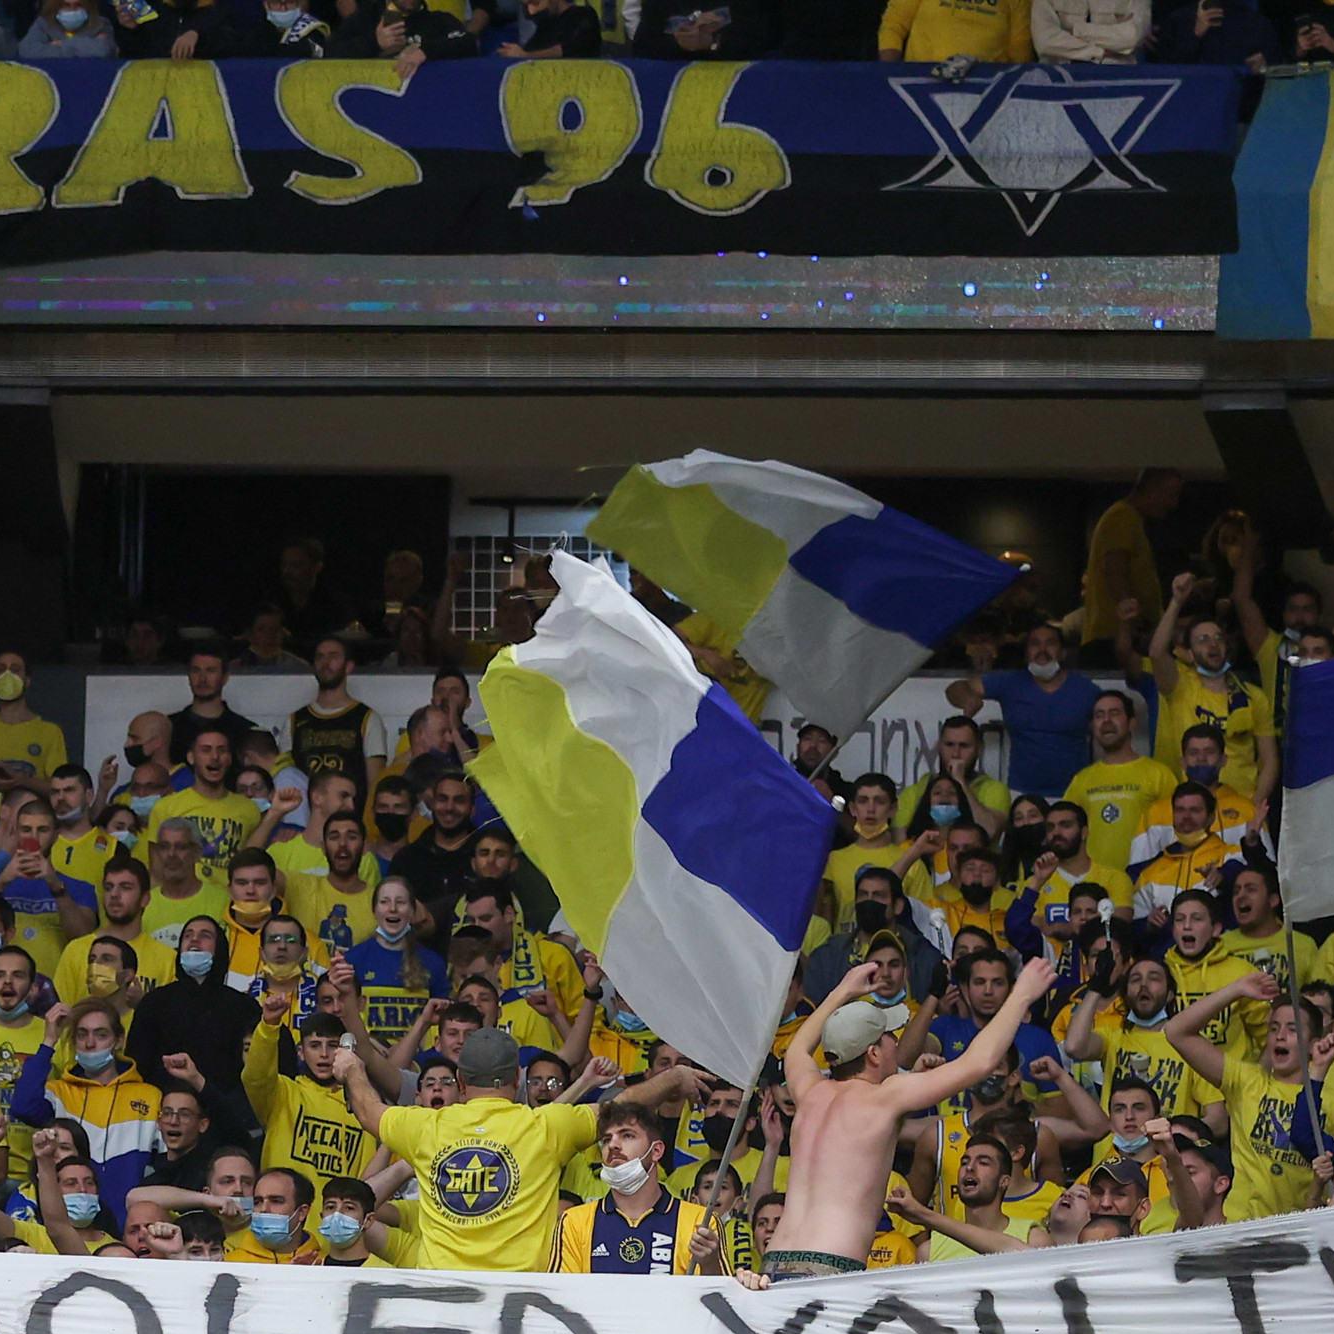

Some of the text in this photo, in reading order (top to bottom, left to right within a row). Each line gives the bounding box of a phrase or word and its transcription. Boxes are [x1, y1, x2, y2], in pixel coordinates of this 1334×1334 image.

[499, 59, 791, 217] 96
[221, 816, 244, 835] I'M
[65, 846, 74, 864] 1
[445, 1165, 502, 1195] GATE
